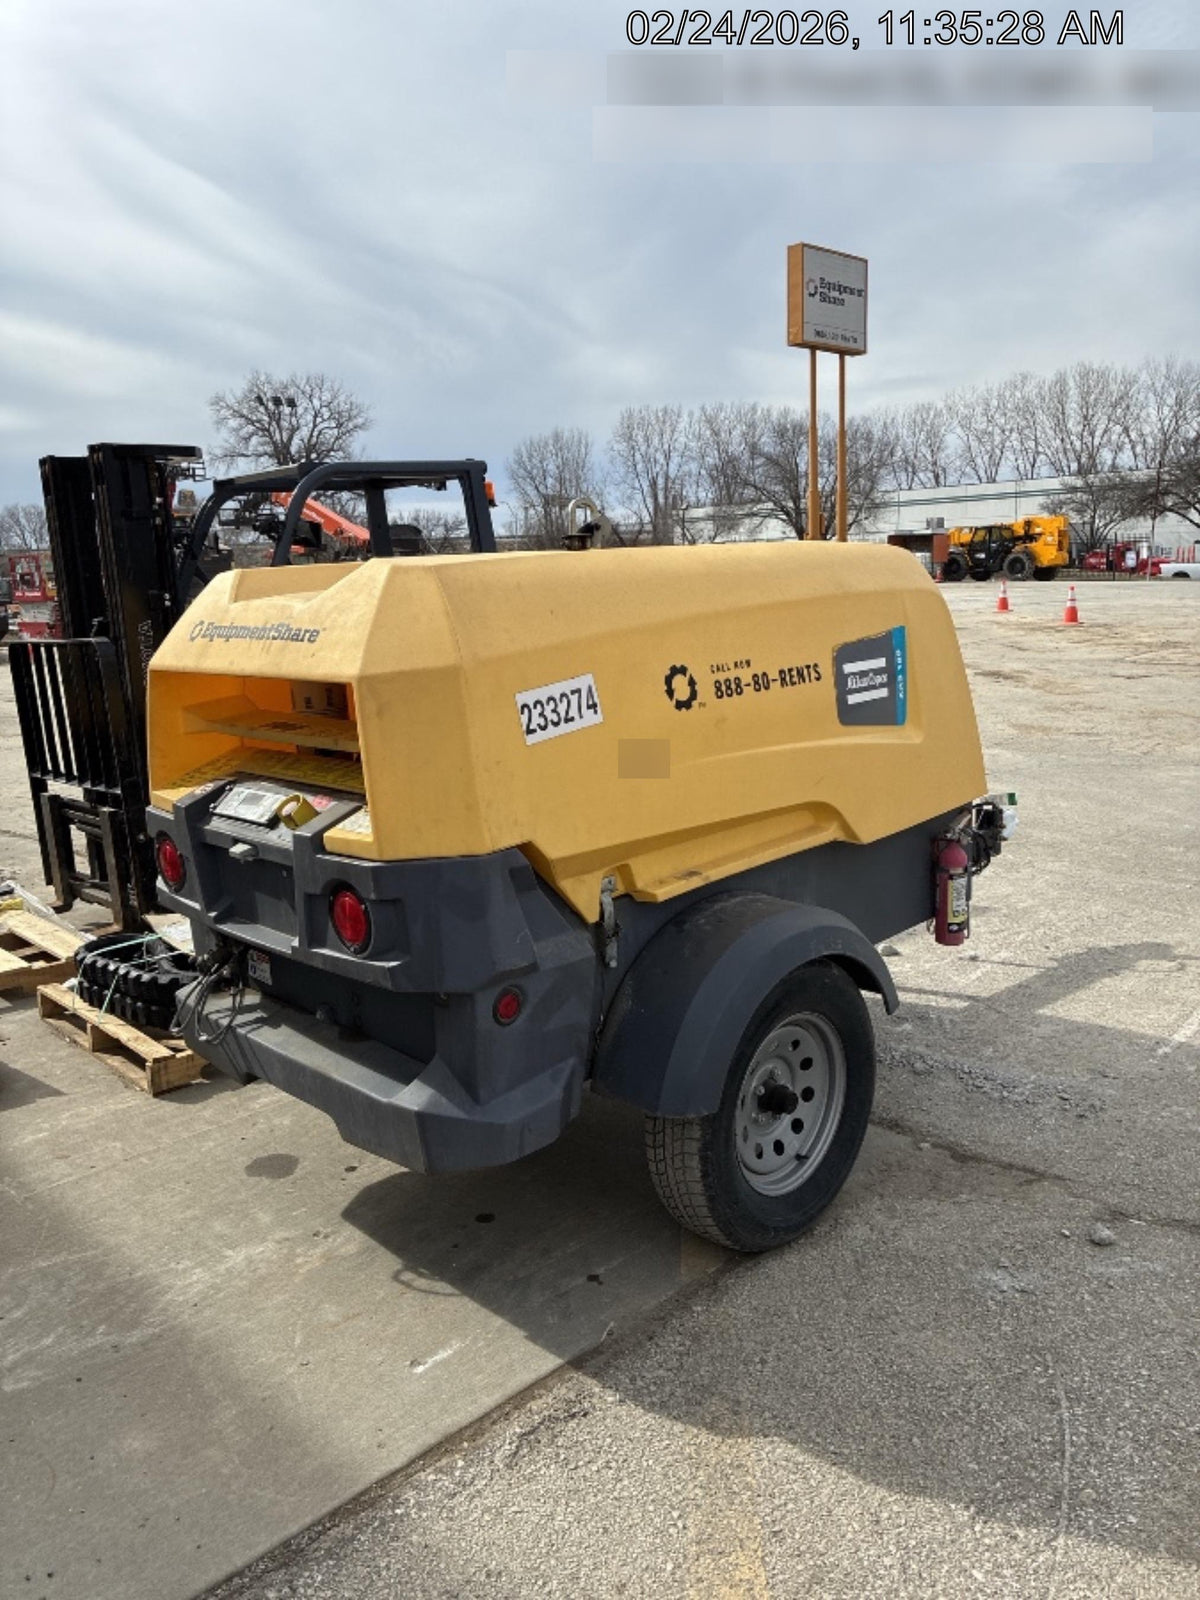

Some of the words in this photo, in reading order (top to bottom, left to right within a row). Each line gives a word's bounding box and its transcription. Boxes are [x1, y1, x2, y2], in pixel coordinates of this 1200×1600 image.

[201, 621, 320, 643] EquipmentShare
[710, 663, 732, 675] CALL
[733, 658, 752, 670] NOW
[714, 662, 822, 700] 888-80-RENTS
[520, 684, 598, 736] 233274
